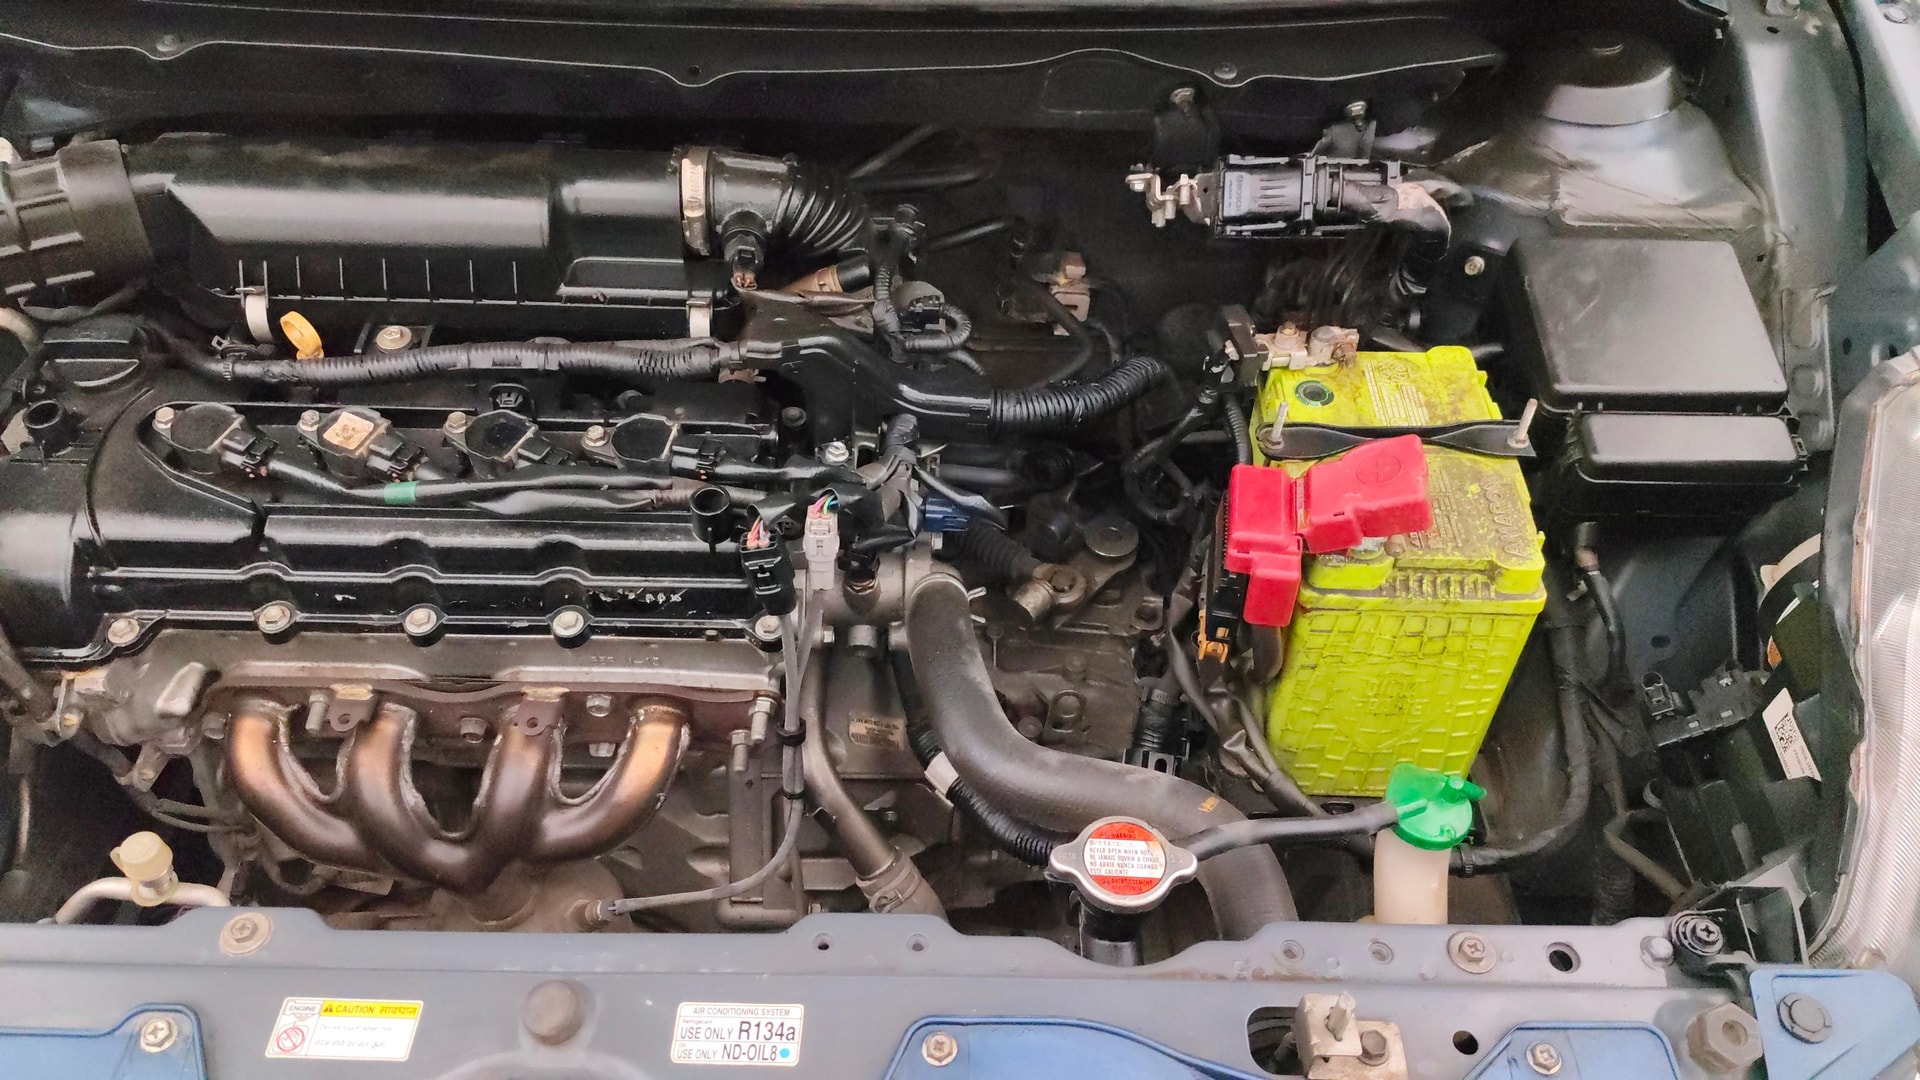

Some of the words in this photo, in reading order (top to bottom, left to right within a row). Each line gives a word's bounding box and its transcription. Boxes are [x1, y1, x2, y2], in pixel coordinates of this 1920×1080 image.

[335, 1005, 375, 1014] CAUTION
[693, 1007, 706, 1015] AIR
[707, 1007, 759, 1016] CONDITIONING
[761, 1008, 790, 1016] SYSTEM
[680, 1026, 701, 1040] USE
[704, 1026, 734, 1040] ONLY
[738, 1021, 796, 1041] R134a
[677, 1049, 694, 1060] USE
[695, 1049, 718, 1060] ONLY
[721, 1044, 778, 1061] ND-OIL8
